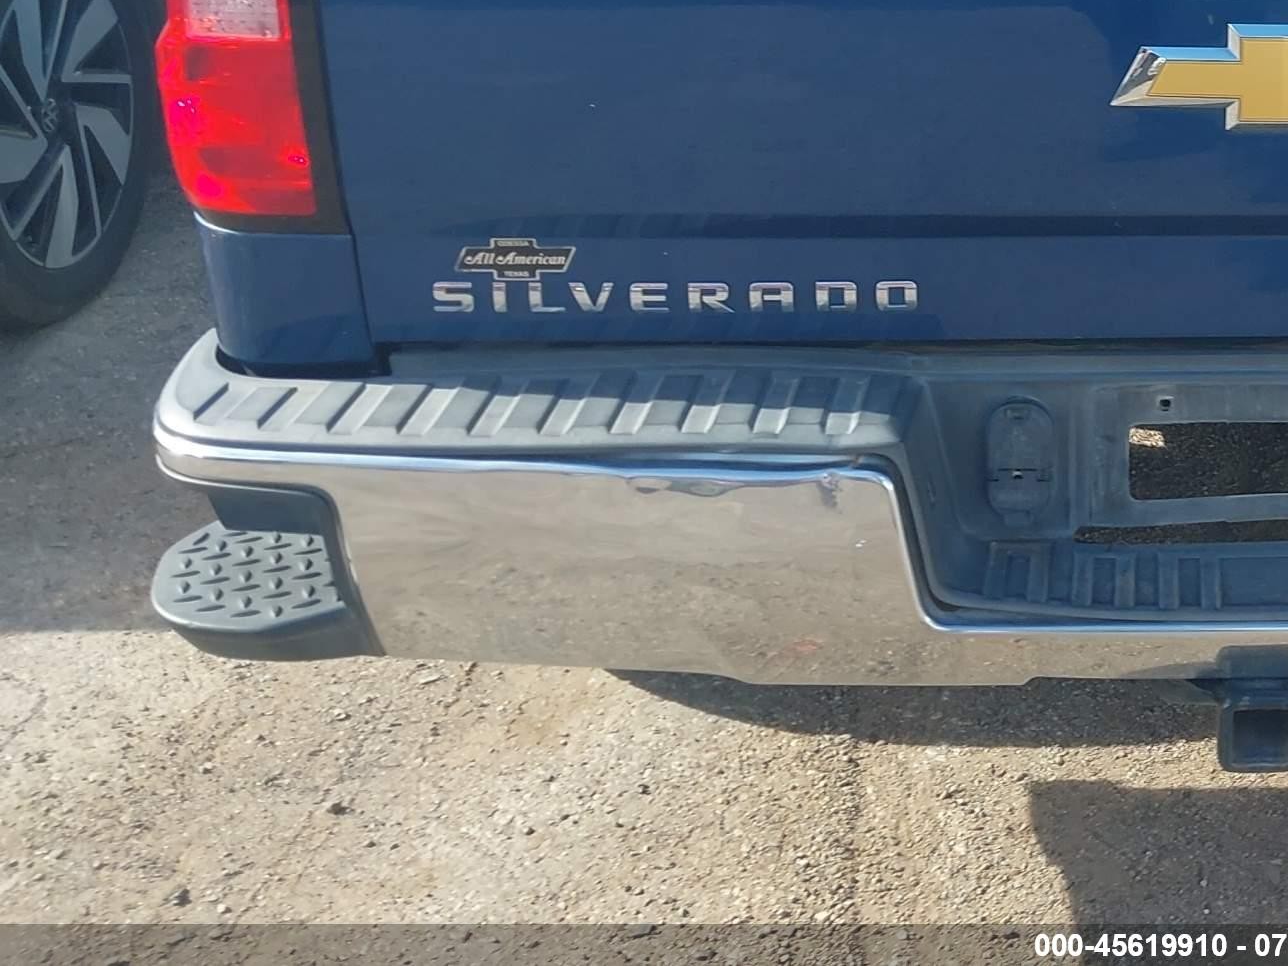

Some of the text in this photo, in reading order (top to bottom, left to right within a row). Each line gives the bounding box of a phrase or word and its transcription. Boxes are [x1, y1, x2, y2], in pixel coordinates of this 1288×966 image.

[464, 252, 566, 265] All American
[432, 280, 919, 313] SILVERADO
